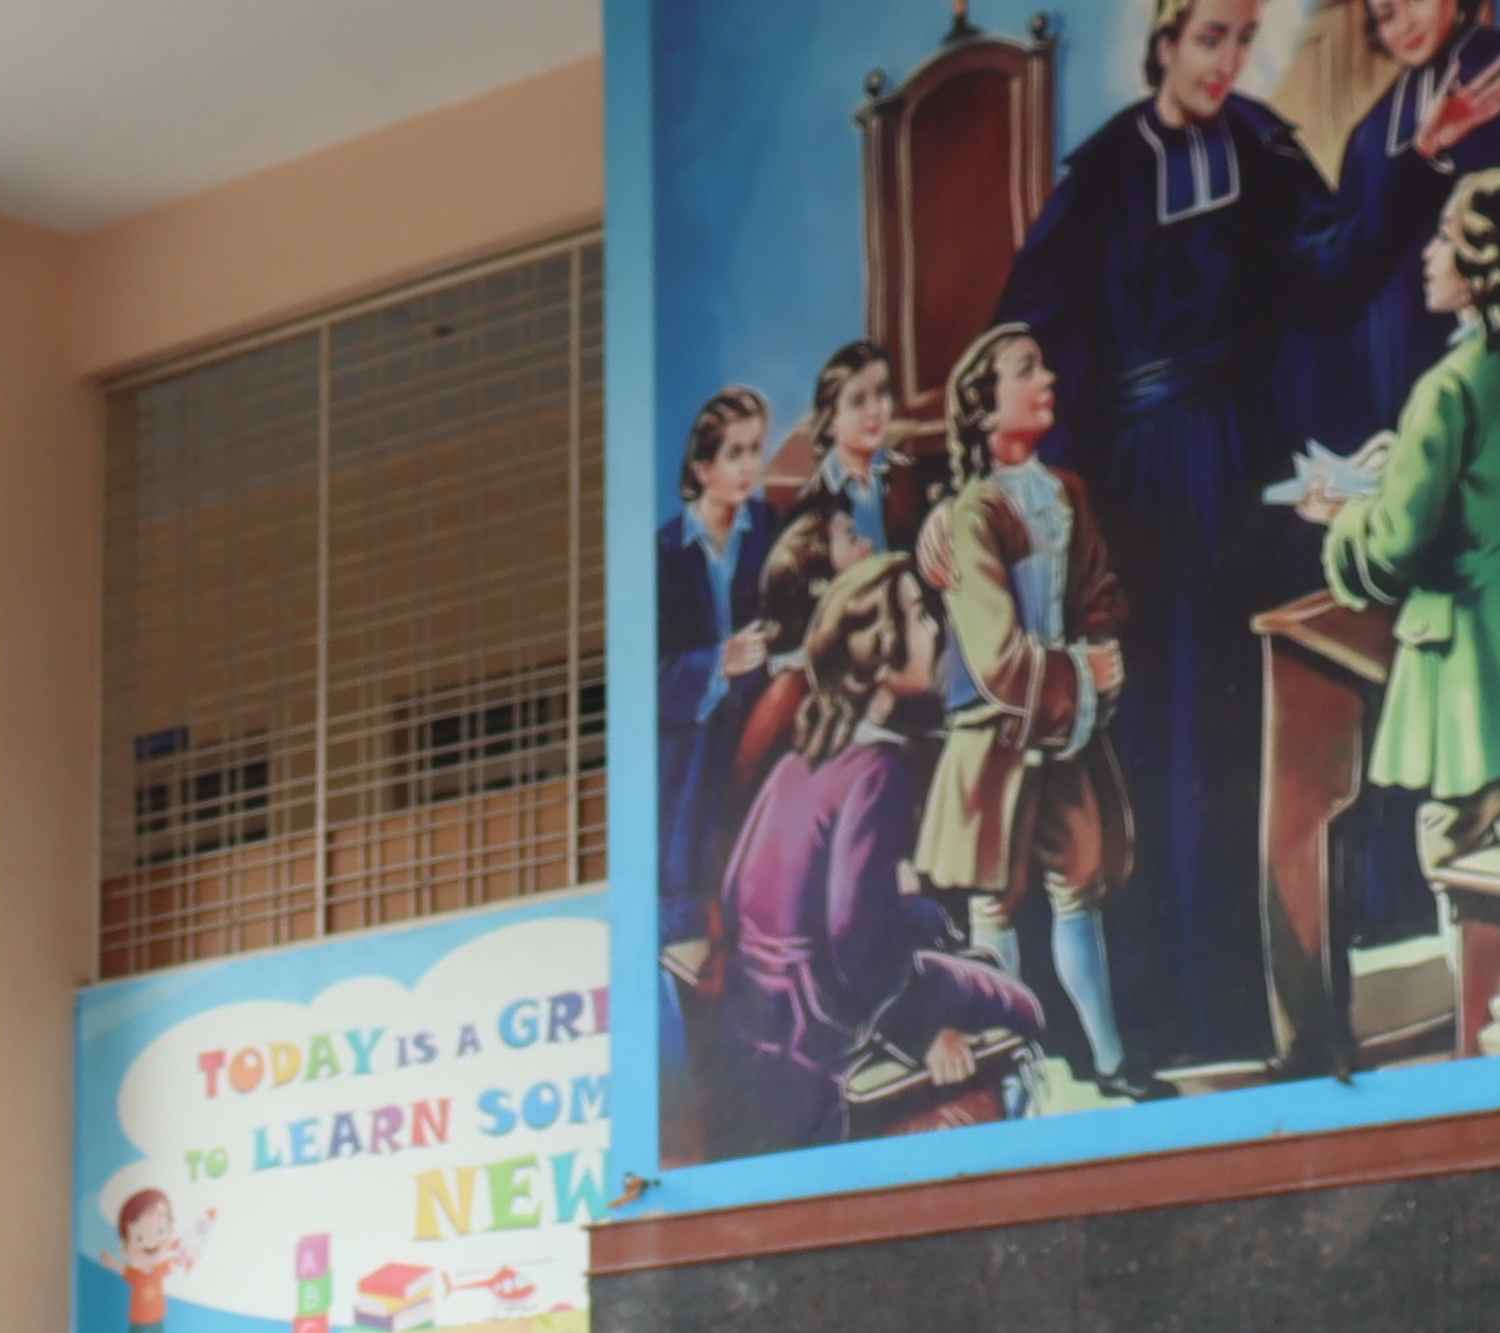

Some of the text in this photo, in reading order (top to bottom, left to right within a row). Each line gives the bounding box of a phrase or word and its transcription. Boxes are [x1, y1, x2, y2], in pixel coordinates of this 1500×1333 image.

[197, 1027, 387, 1099] TODAY
[396, 1031, 439, 1069] IS
[456, 1023, 482, 1057] A
[185, 1074, 612, 1183] TO LEARN SOM
[412, 1148, 612, 1242] NEW
